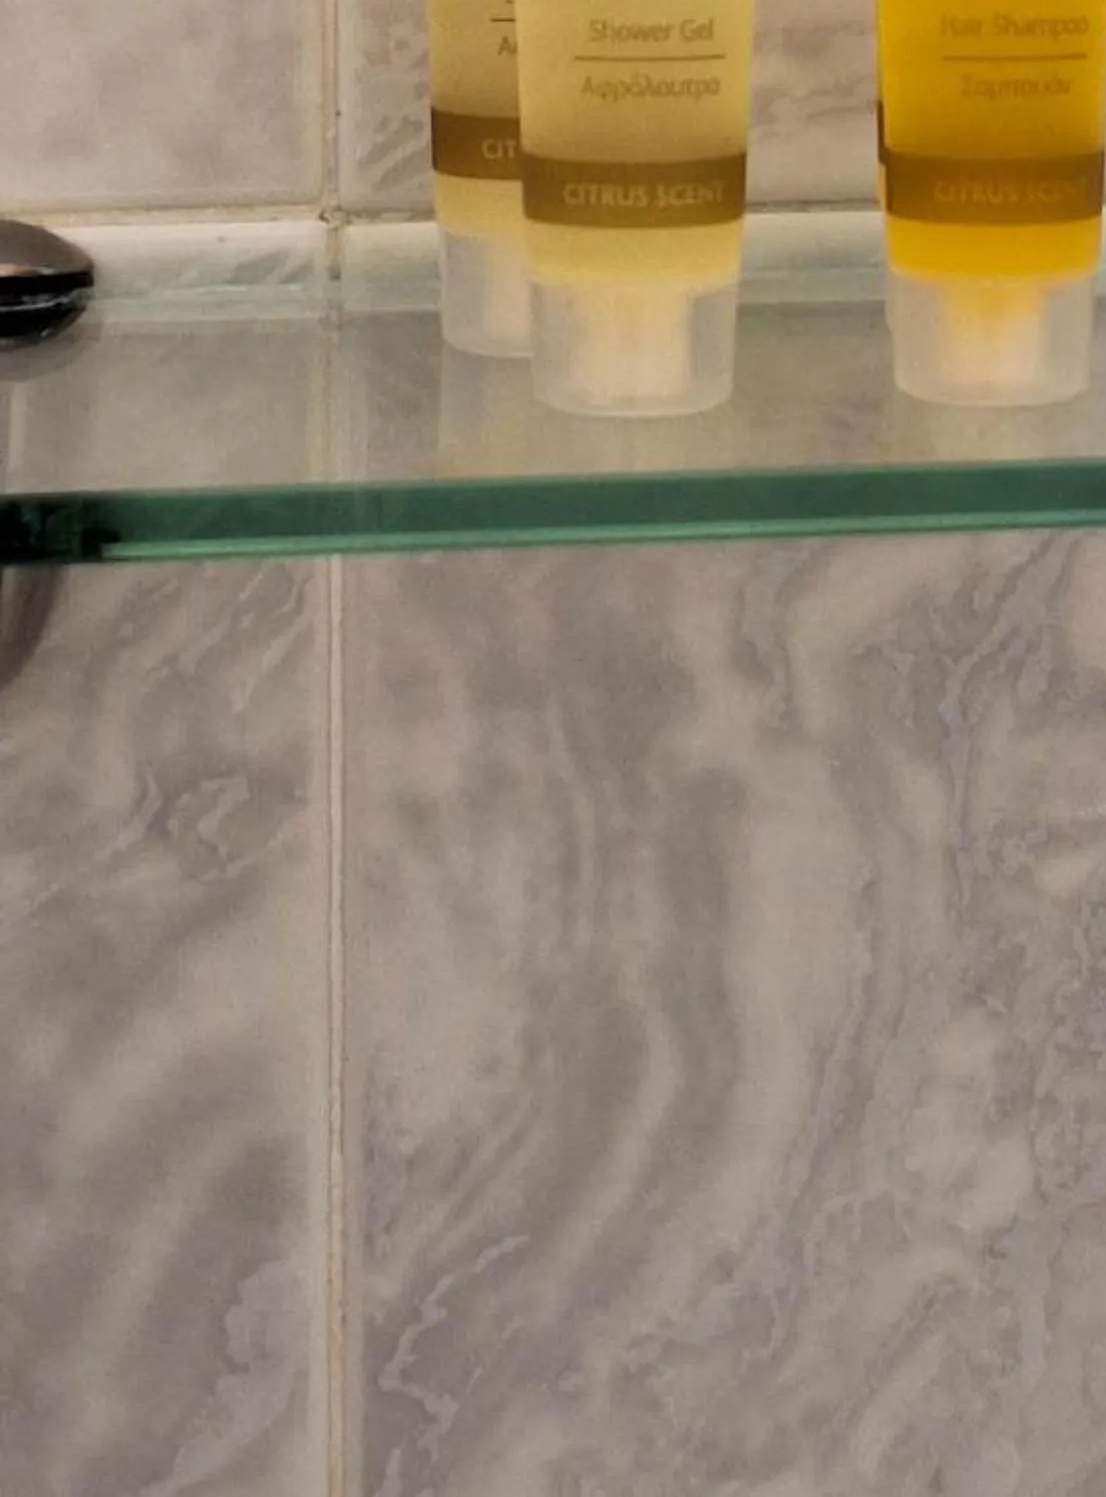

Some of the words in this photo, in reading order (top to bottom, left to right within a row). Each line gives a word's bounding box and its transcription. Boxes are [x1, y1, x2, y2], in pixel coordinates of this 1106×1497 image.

[588, 19, 675, 43] Shower
[679, 18, 714, 42] Gel
[562, 183, 648, 208] CITRUS
[655, 179, 725, 208] SCENT
